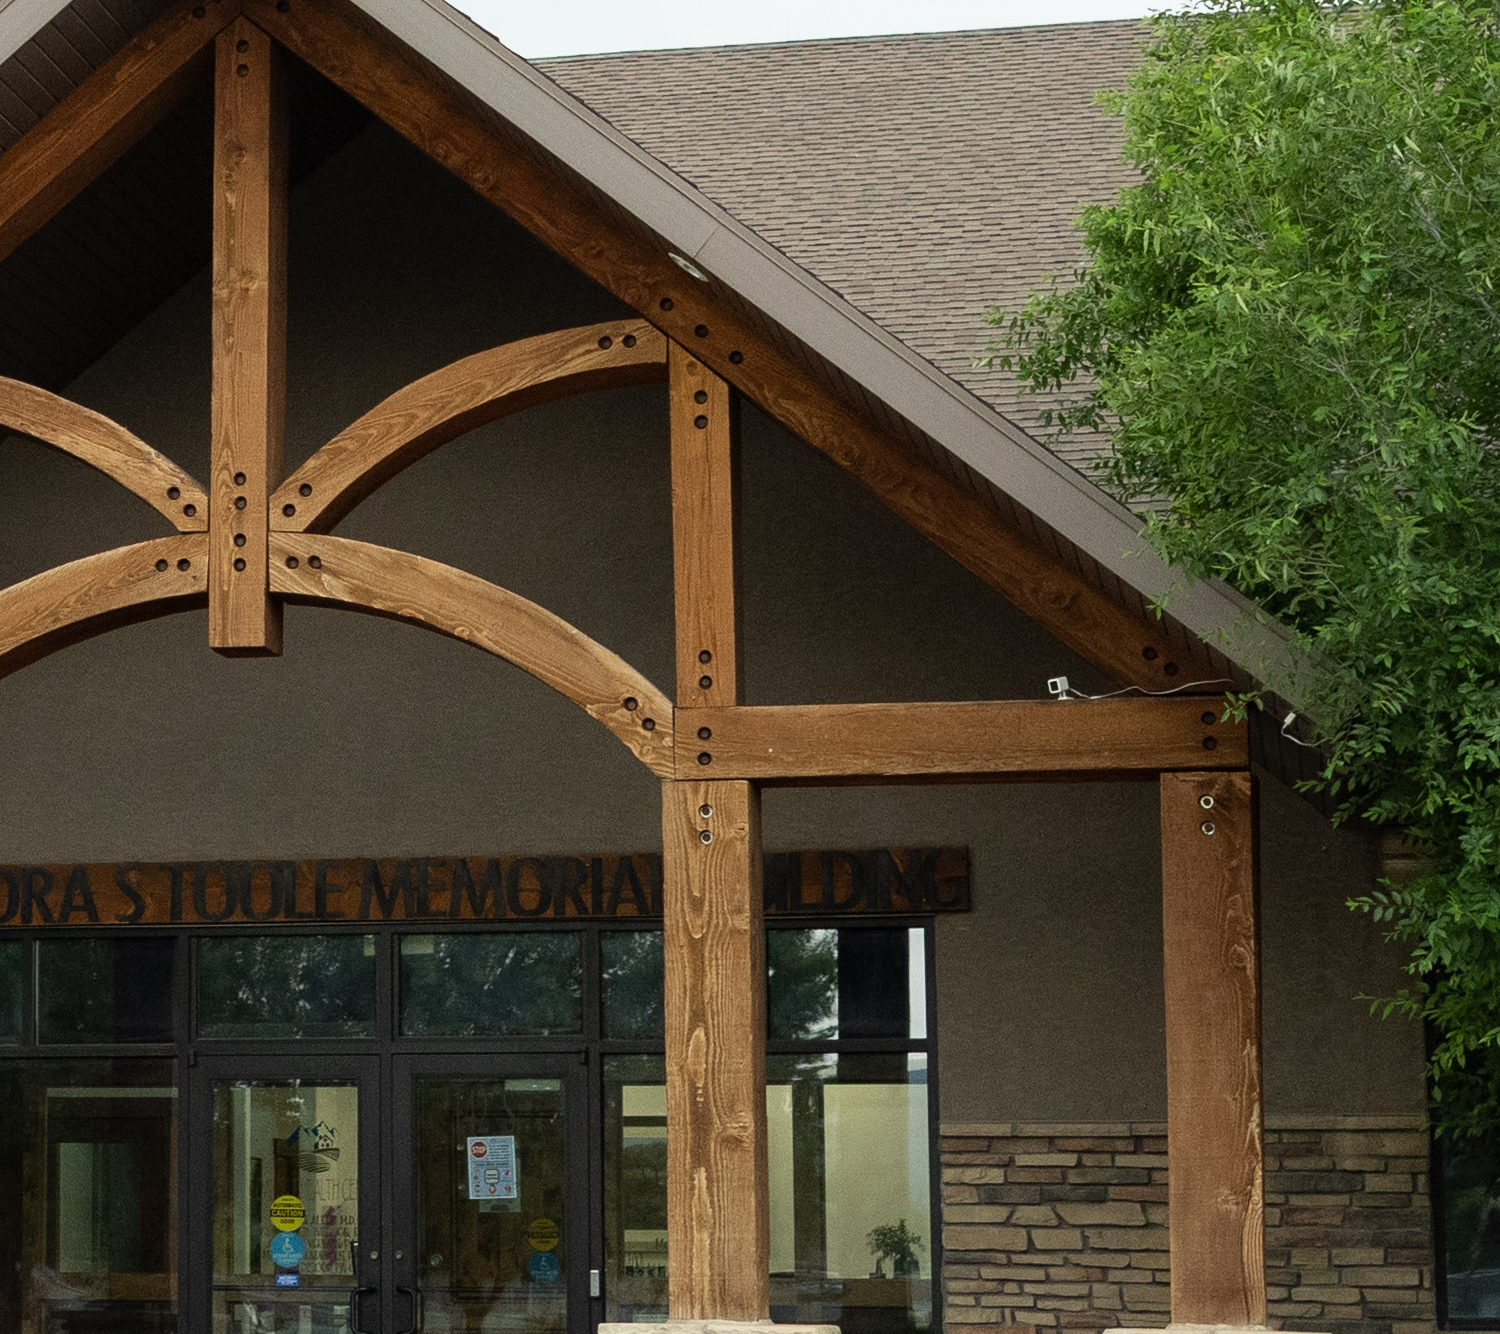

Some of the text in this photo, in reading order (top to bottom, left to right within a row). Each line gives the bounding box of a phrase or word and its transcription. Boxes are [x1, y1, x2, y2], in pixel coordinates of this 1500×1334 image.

[112, 861, 149, 923] S
[158, 858, 345, 921] TOOLE
[763, 848, 969, 912] ILDING
